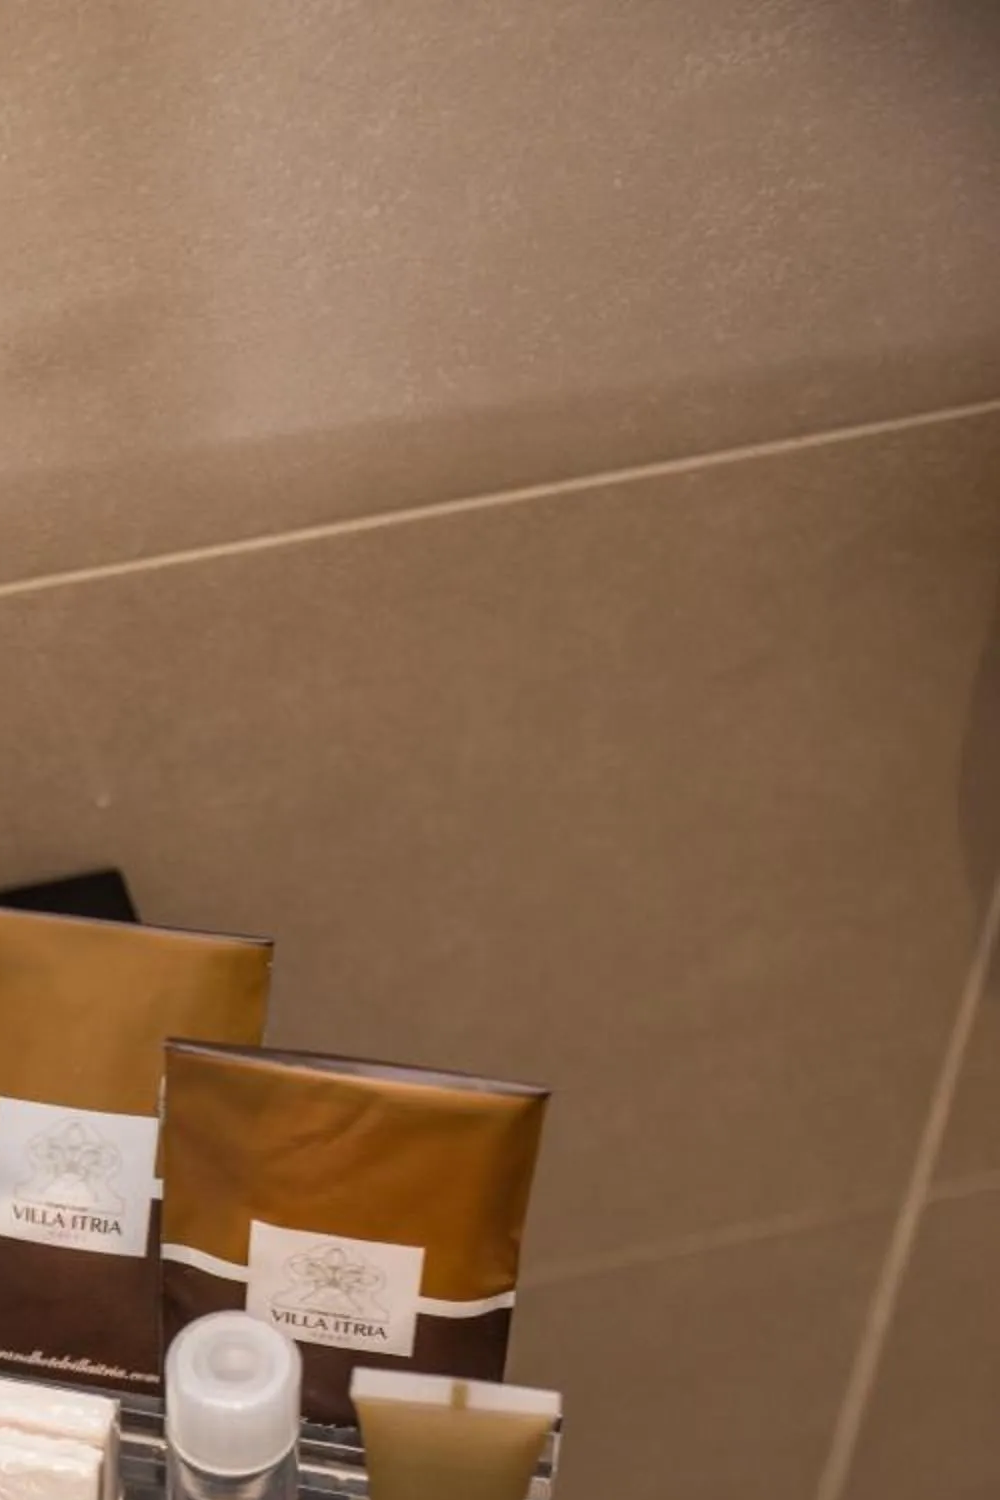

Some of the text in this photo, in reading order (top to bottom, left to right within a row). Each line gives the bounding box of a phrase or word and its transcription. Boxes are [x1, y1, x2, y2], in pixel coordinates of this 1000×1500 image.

[12, 1204, 66, 1229] VILLA
[71, 1215, 122, 1236] ITRIA
[271, 1309, 328, 1331] VILLA
[334, 1320, 388, 1340] ITRIA
